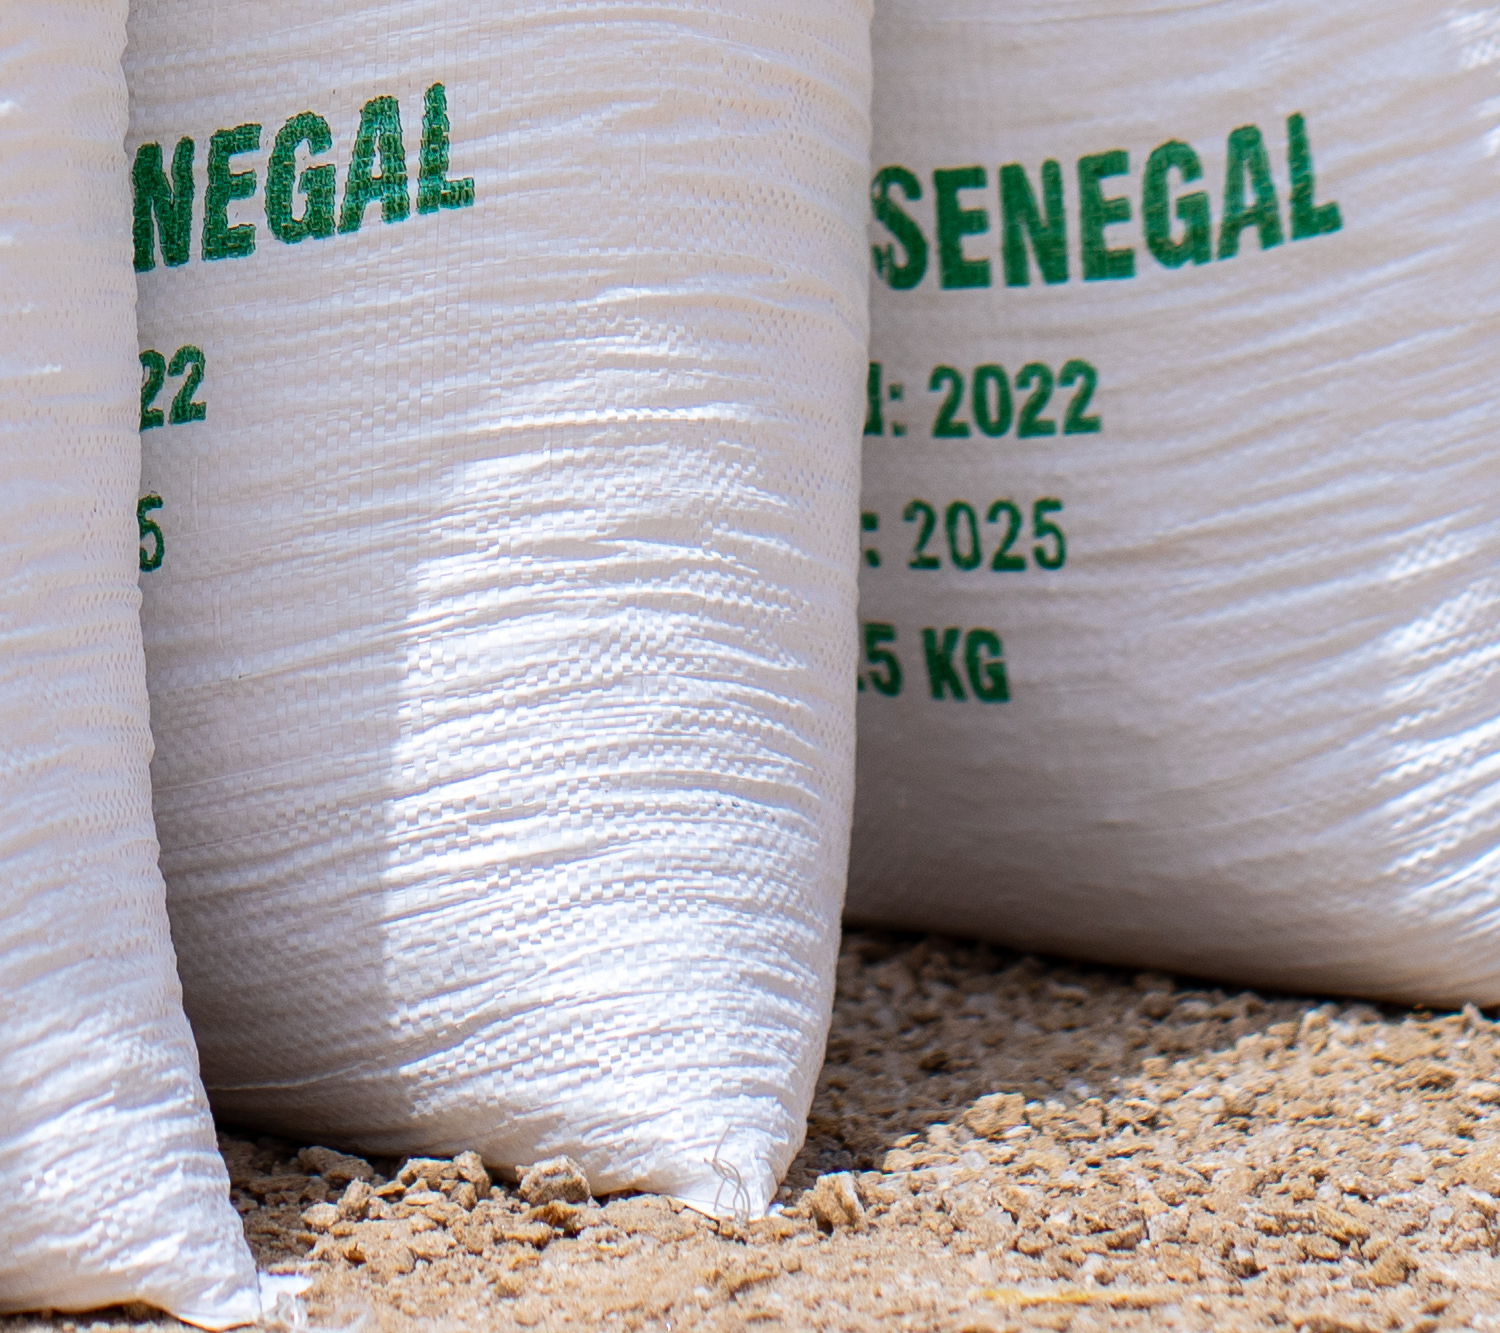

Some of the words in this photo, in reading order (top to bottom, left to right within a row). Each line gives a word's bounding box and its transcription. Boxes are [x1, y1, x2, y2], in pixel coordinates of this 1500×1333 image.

[870, 111, 1344, 291] SENEGAL
[927, 359, 1102, 440] 2022
[902, 497, 1067, 573] 2025
[920, 627, 1010, 703] KG
